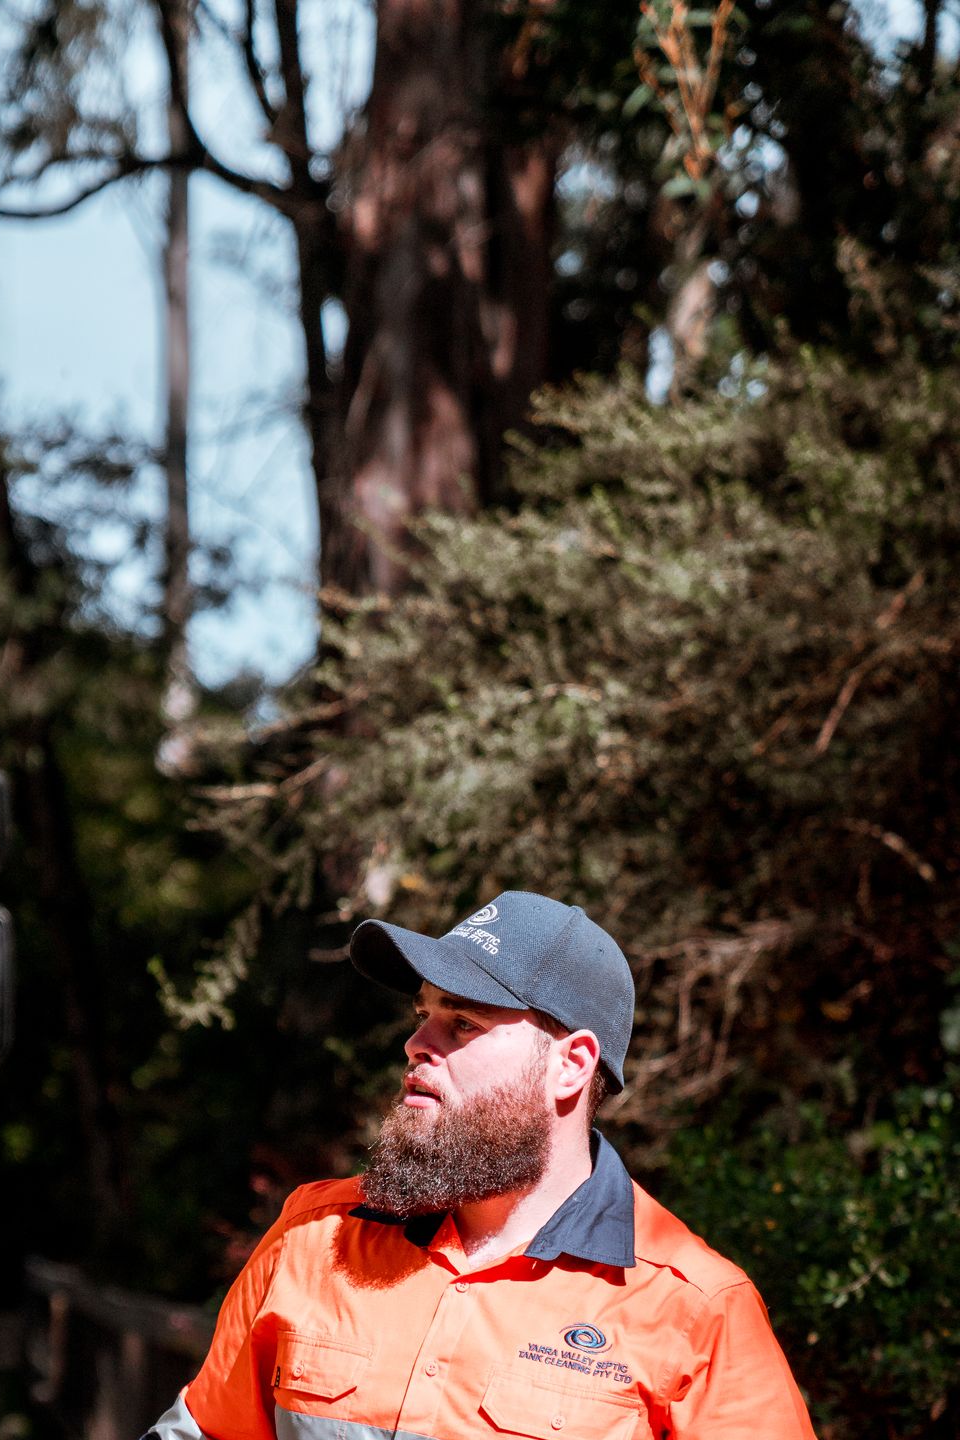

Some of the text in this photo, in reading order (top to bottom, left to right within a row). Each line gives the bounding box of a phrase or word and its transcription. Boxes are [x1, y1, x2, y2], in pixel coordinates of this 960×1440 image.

[468, 935, 499, 955] PTY LTD
[476, 929, 500, 946] SEPTIC
[518, 1350, 633, 1384] TANK CLEANING PTY LTD
[528, 1343, 628, 1374] YARRA VALLEY SEPTIC
